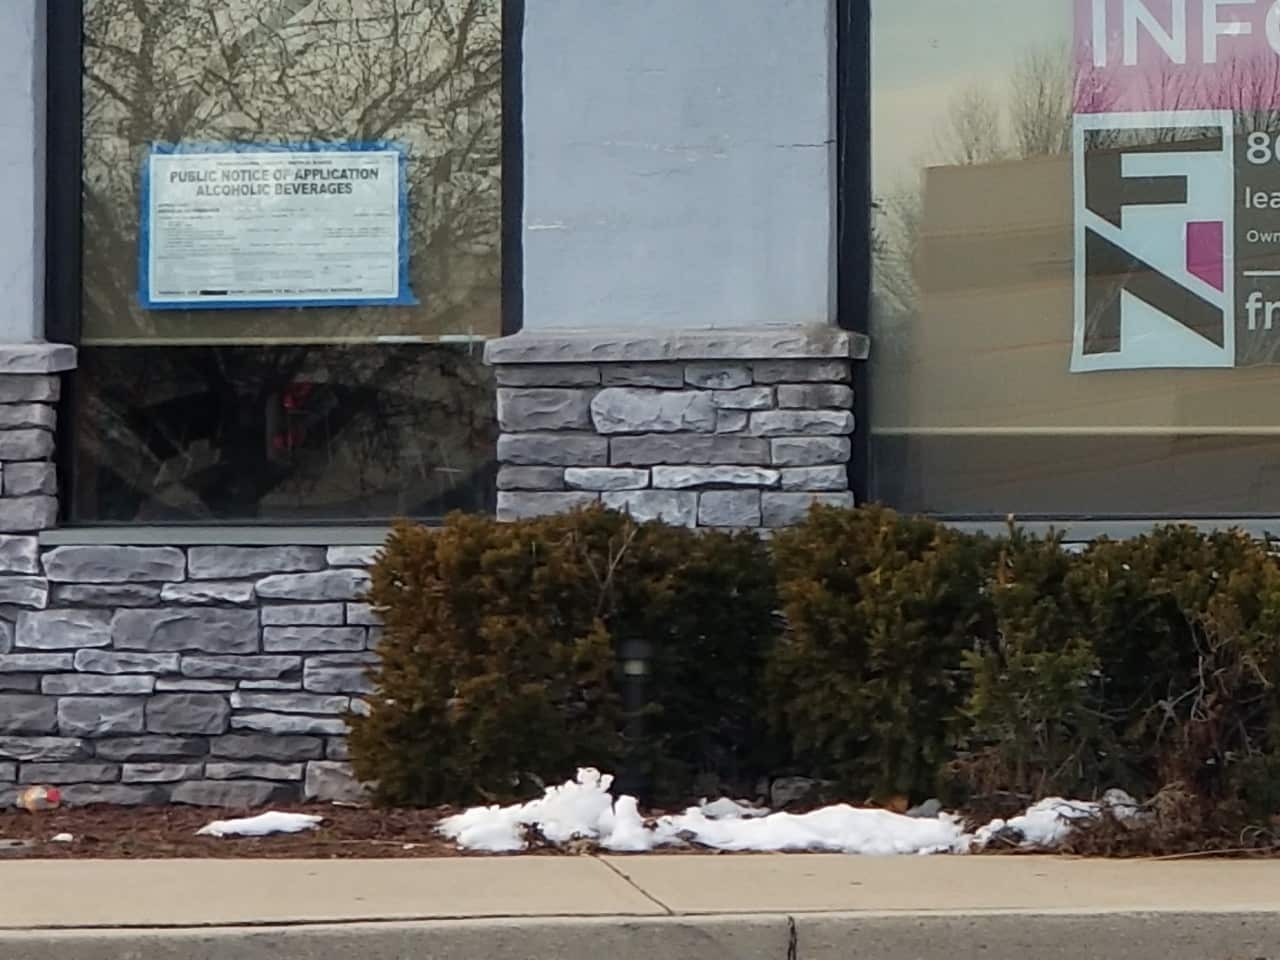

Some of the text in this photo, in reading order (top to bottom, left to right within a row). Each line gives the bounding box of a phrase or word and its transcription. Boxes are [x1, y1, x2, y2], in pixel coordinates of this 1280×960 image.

[169, 170, 217, 183] PUBLIC
[221, 169, 270, 182] NOTICE
[294, 167, 379, 181] APPLICATION
[196, 181, 353, 197] ALCOHOLIC BEVERAGES
